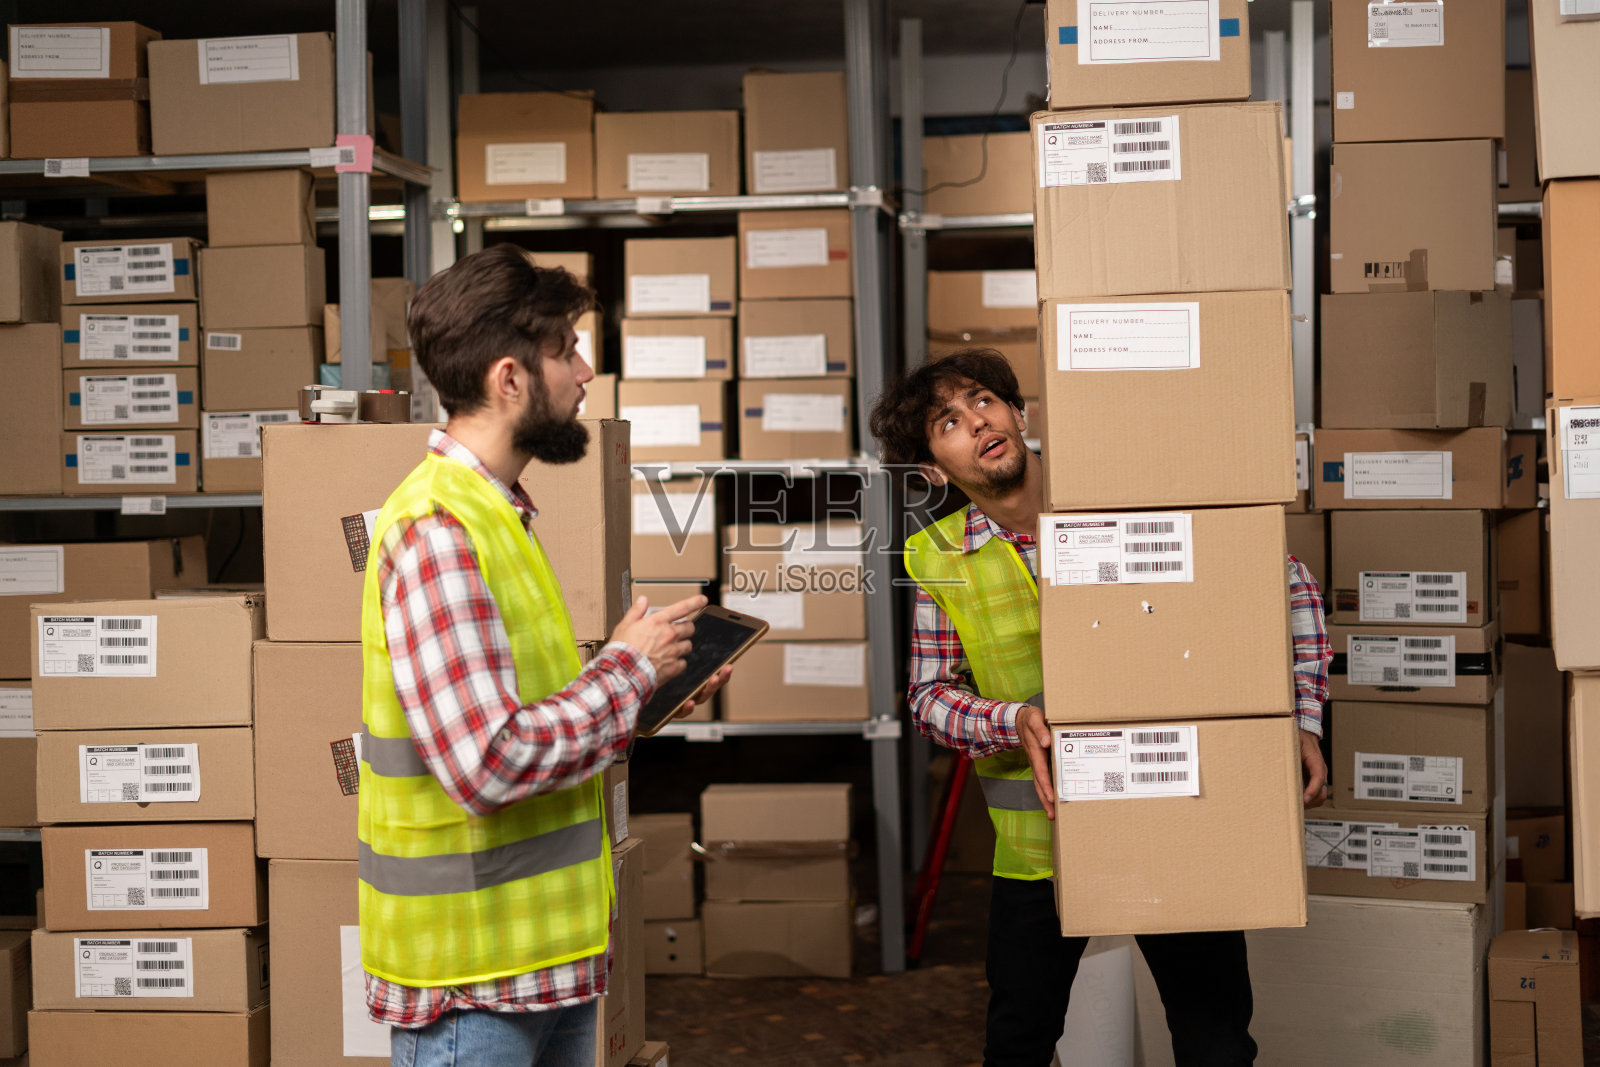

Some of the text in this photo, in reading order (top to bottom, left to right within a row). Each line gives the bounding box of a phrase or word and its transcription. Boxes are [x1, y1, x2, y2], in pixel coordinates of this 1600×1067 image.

[1048, 135, 1057, 145] Q
[1058, 534, 1068, 543] Q
[46, 627, 54, 636] Q
[1064, 743, 1074, 753] Q
[89, 757, 98, 766] Q
[94, 861, 102, 870] Q
[82, 950, 91, 959] Q
